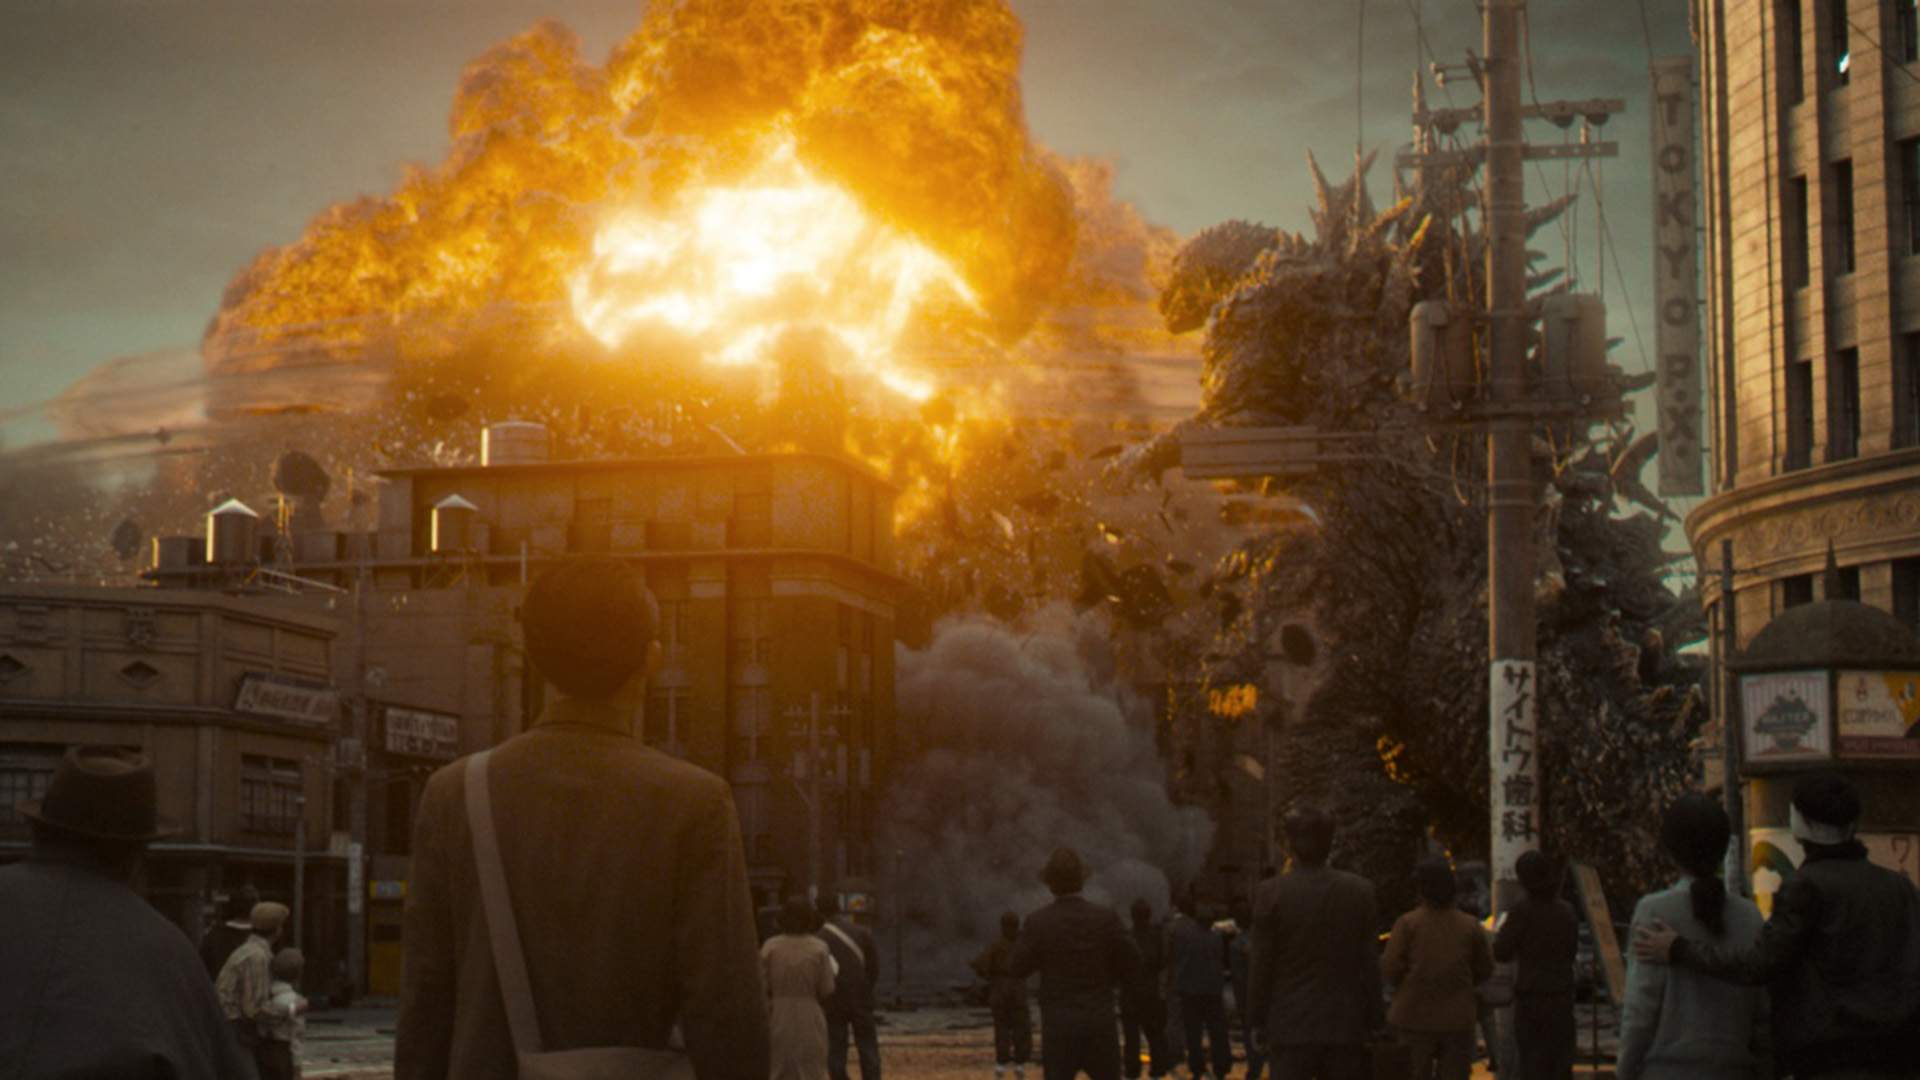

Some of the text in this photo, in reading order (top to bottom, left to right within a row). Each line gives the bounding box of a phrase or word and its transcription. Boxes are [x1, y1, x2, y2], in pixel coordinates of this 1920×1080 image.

[1658, 92, 1691, 327] TOKYO
[1502, 665, 1536, 842] サイトウ歯科
